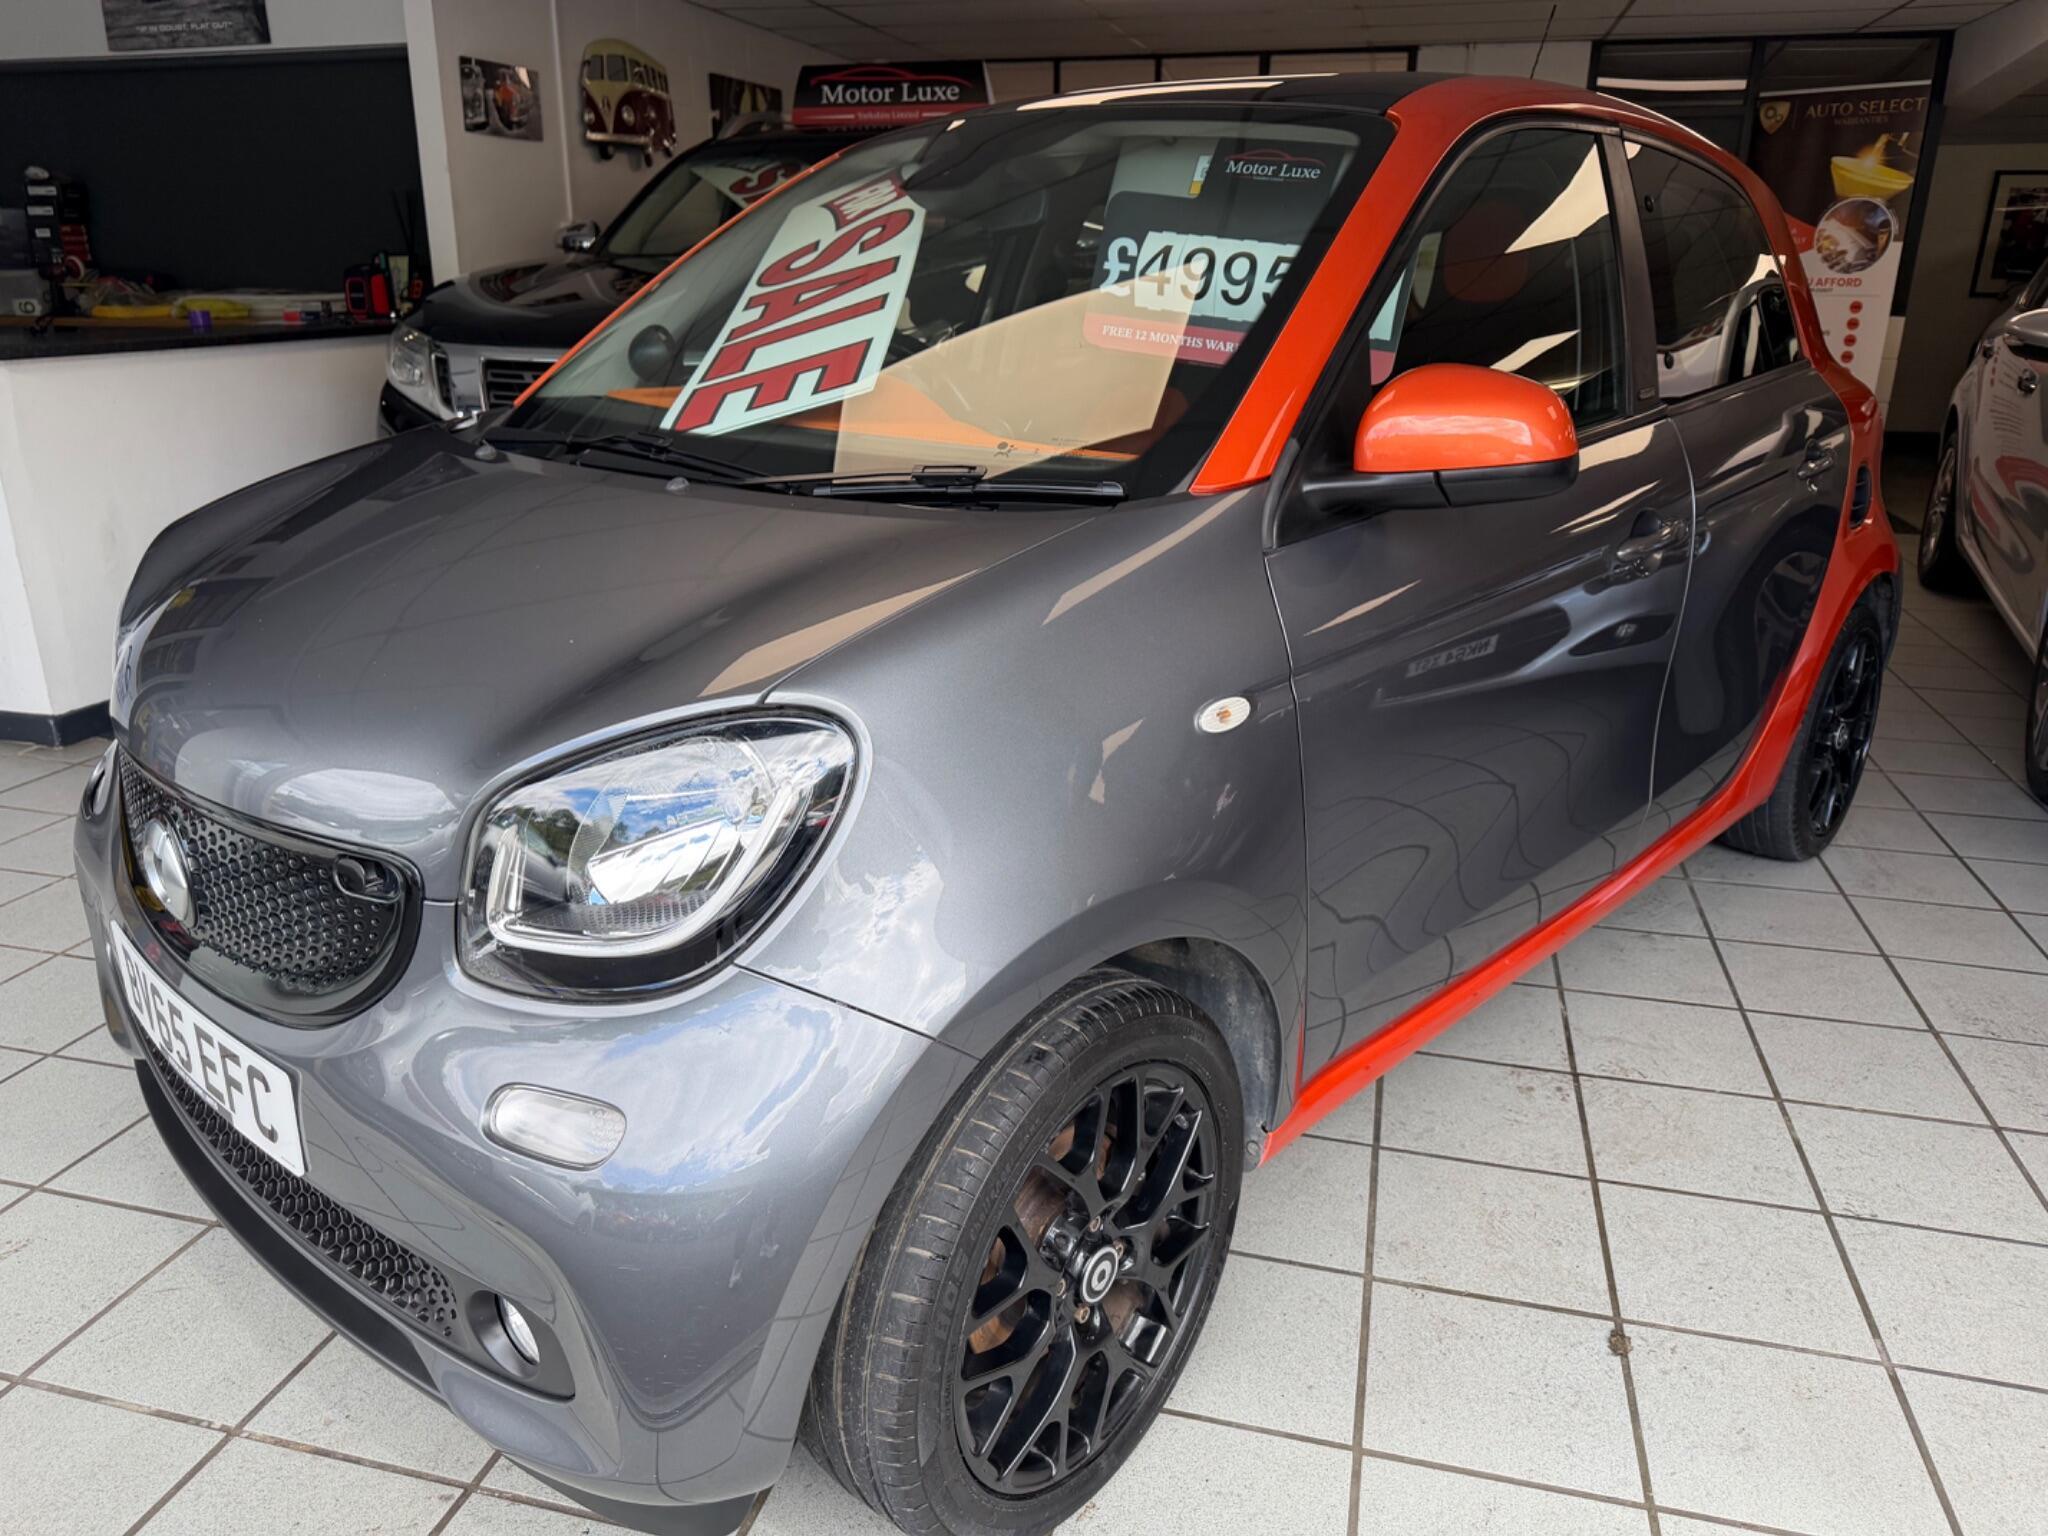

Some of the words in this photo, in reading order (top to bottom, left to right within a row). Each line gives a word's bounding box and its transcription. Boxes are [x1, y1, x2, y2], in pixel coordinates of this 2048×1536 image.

[821, 84, 895, 105] Motor
[901, 82, 961, 103] Luxe
[1805, 101, 1854, 118] AUTO
[1859, 96, 1928, 114] SELECT
[1225, 160, 1277, 176] Motor
[1280, 163, 1321, 179] Luxe
[1815, 277, 1863, 288] AFFORD
[673, 208, 915, 432] SALE
[1102, 324, 1133, 339] FREE
[1136, 328, 1148, 341] 12
[1150, 332, 1203, 348] MONTHS
[1205, 338, 1240, 353] WAR
[193, 1021, 279, 1144] EFC
